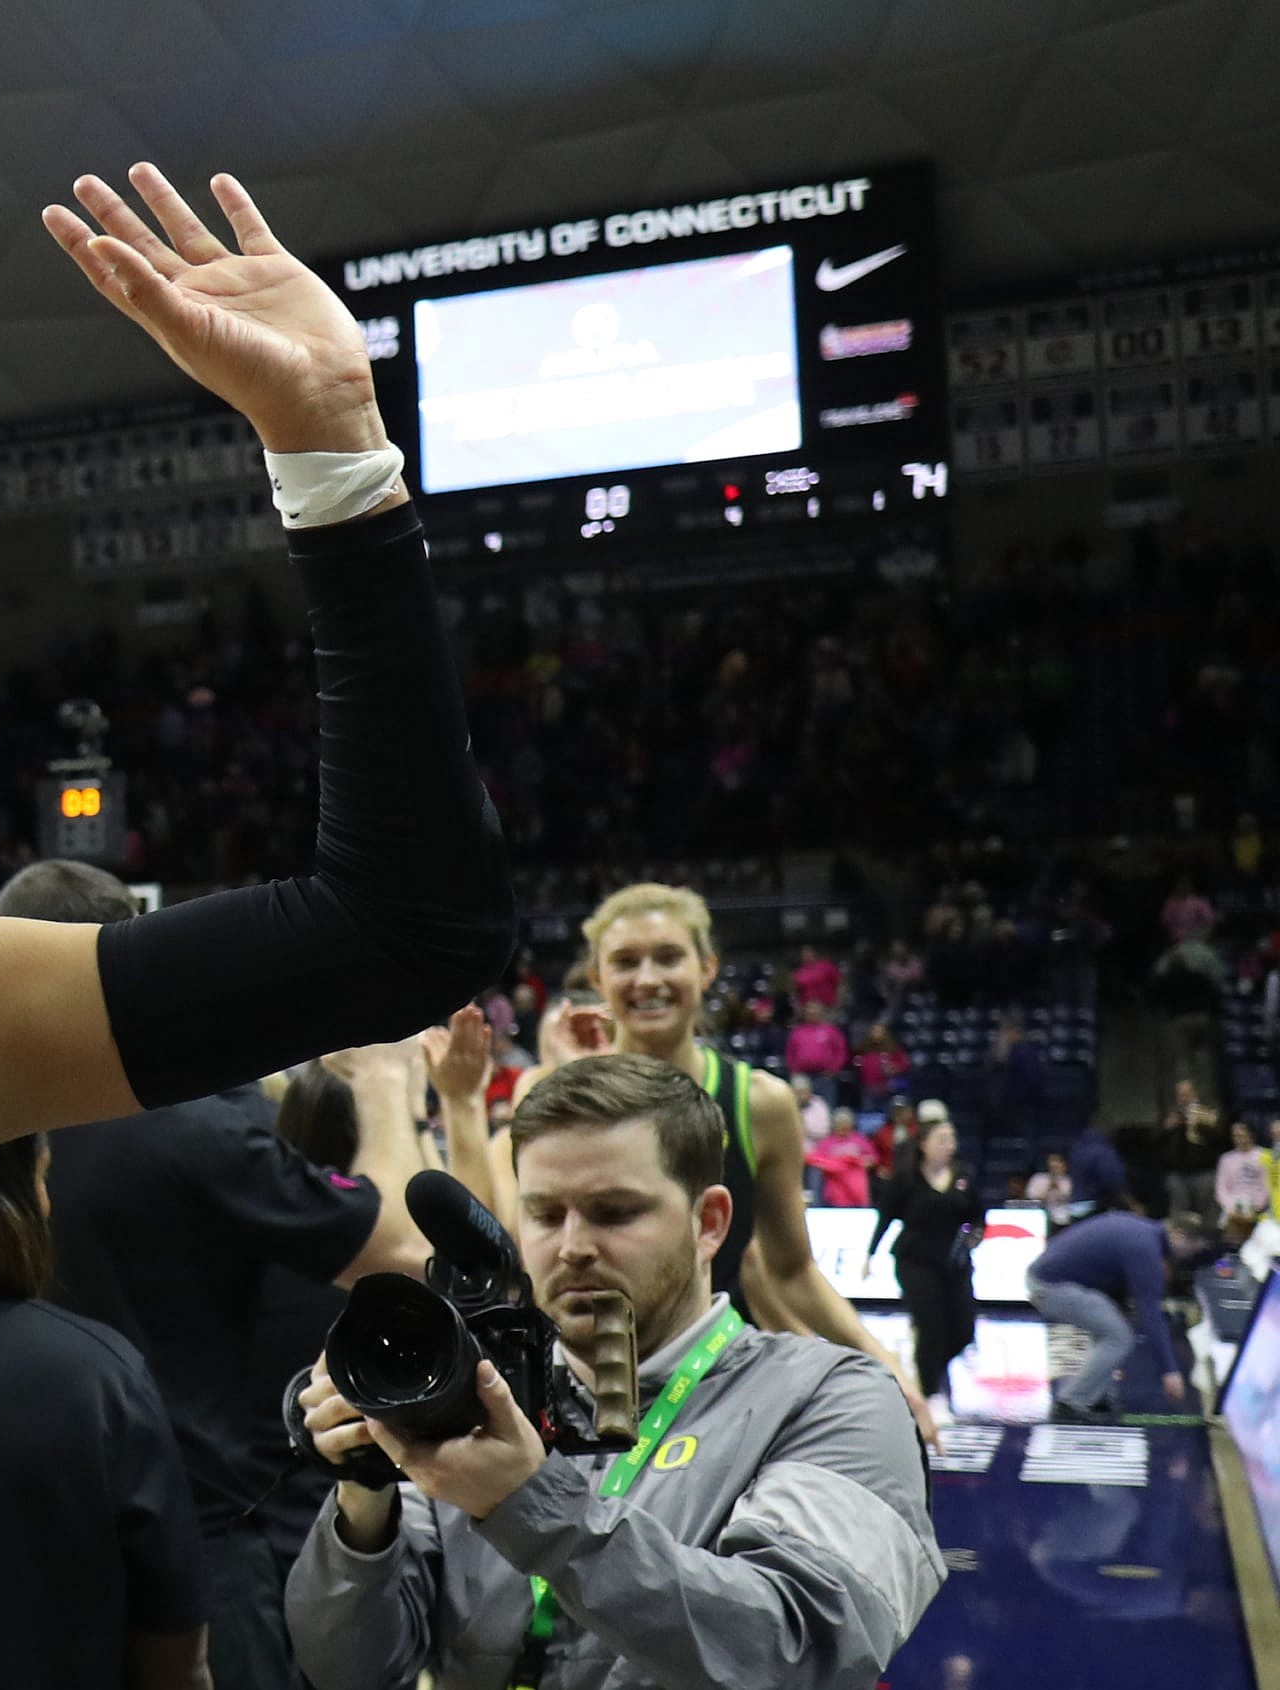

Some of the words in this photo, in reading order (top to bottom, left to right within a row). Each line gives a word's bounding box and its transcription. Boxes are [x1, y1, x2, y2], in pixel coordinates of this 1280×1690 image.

[343, 227, 547, 291] UNIVERSITY
[549, 218, 600, 256] OF
[604, 177, 872, 248] CONNECTICUT
[900, 461, 949, 500] 74
